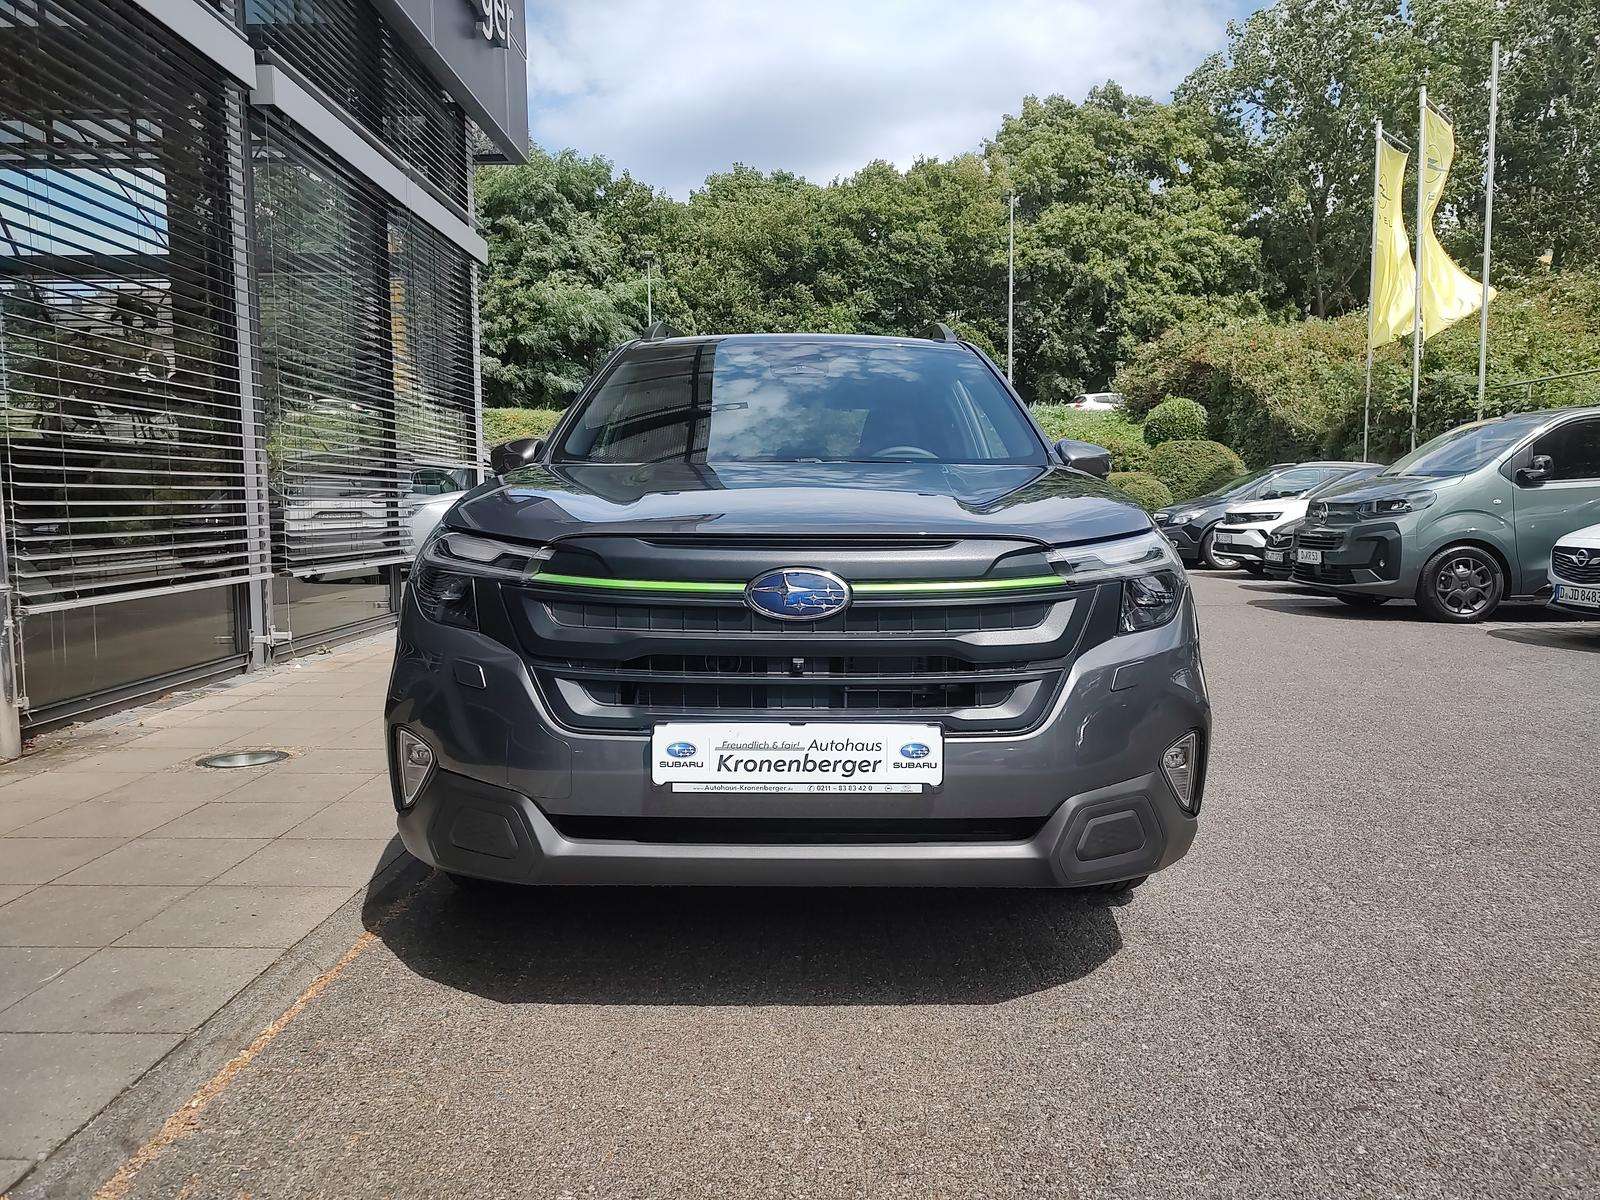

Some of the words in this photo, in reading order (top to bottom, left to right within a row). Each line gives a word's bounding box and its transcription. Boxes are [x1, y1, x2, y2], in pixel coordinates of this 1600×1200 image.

[721, 741, 770, 750] Freundlich
[772, 741, 778, 750] &
[780, 741, 800, 751] fair!
[807, 738, 882, 752] Autohaus
[716, 753, 883, 778] Kronenberger
